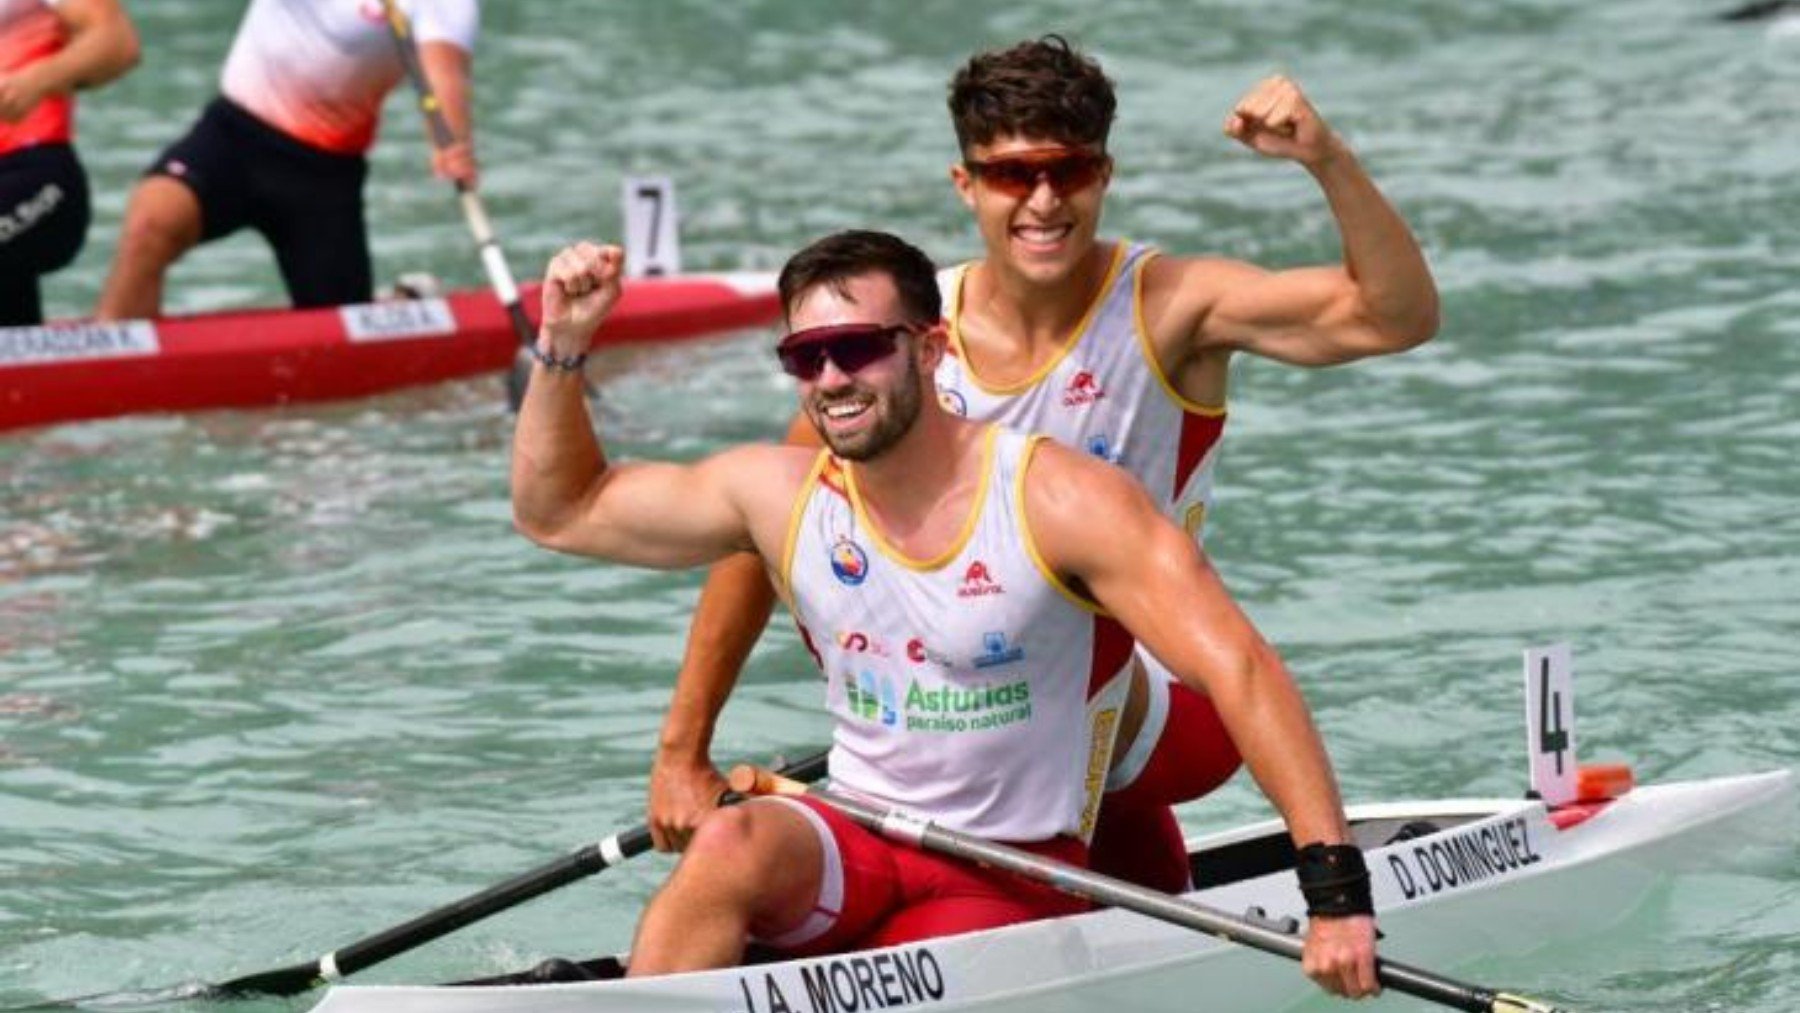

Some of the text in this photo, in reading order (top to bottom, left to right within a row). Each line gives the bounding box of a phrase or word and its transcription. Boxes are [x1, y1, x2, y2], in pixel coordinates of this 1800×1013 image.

[637, 187, 662, 258] 7
[906, 680, 1029, 712] Asturias
[970, 702, 1031, 730] natural
[1541, 657, 1568, 775] 4
[1388, 817, 1541, 899] D. DOMINGUEZ
[801, 948, 944, 1013] MORENO
